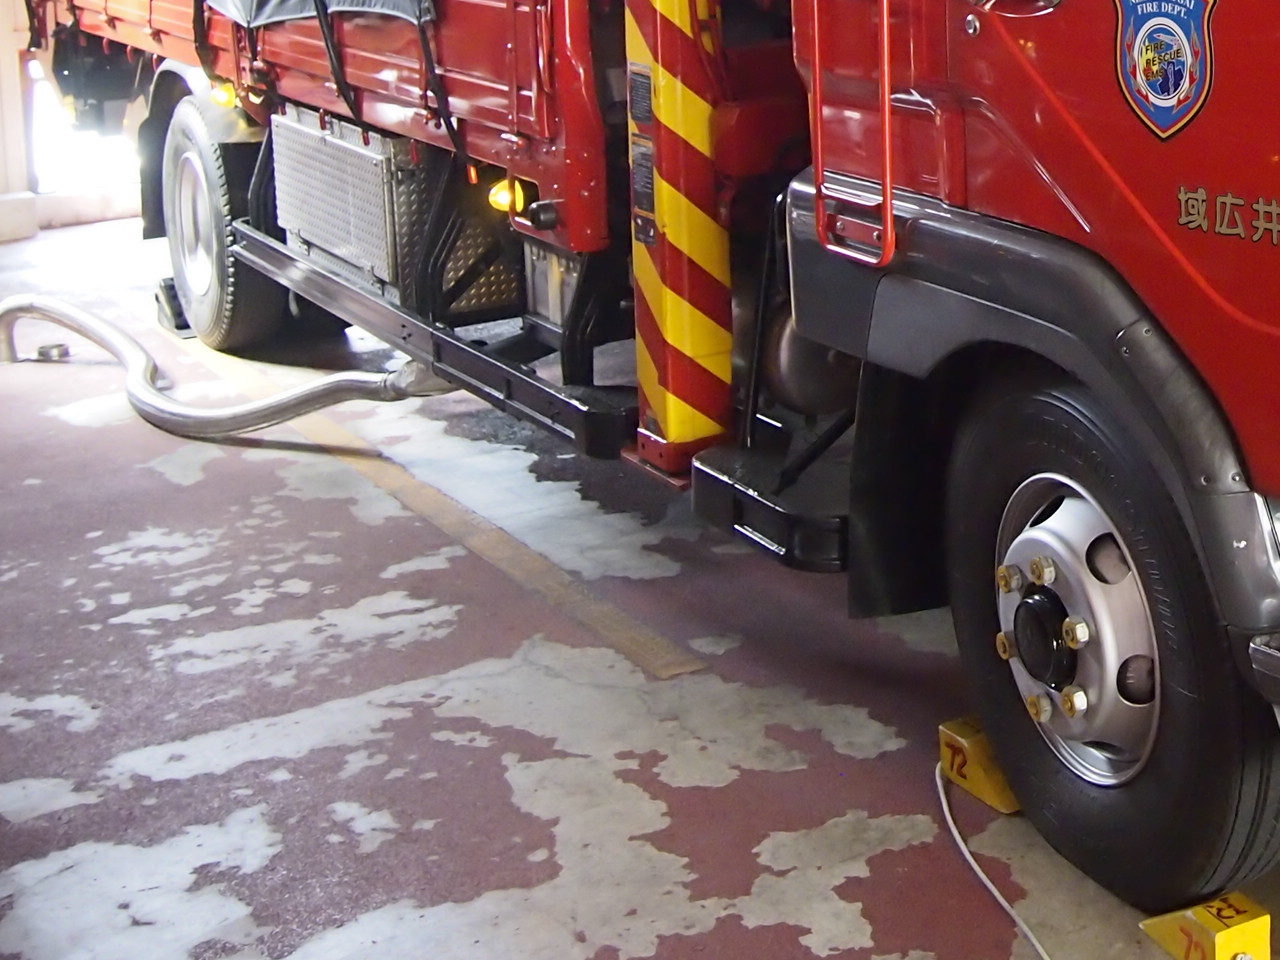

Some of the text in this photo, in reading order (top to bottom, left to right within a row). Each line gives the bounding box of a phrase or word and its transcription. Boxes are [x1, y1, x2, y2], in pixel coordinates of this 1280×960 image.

[1137, 1, 1188, 19] FIRE DEPT.
[1145, 41, 1165, 55] FIRE
[1145, 49, 1182, 67] RESCUE
[1145, 69, 1165, 81] EMS
[944, 741, 968, 780] 72
